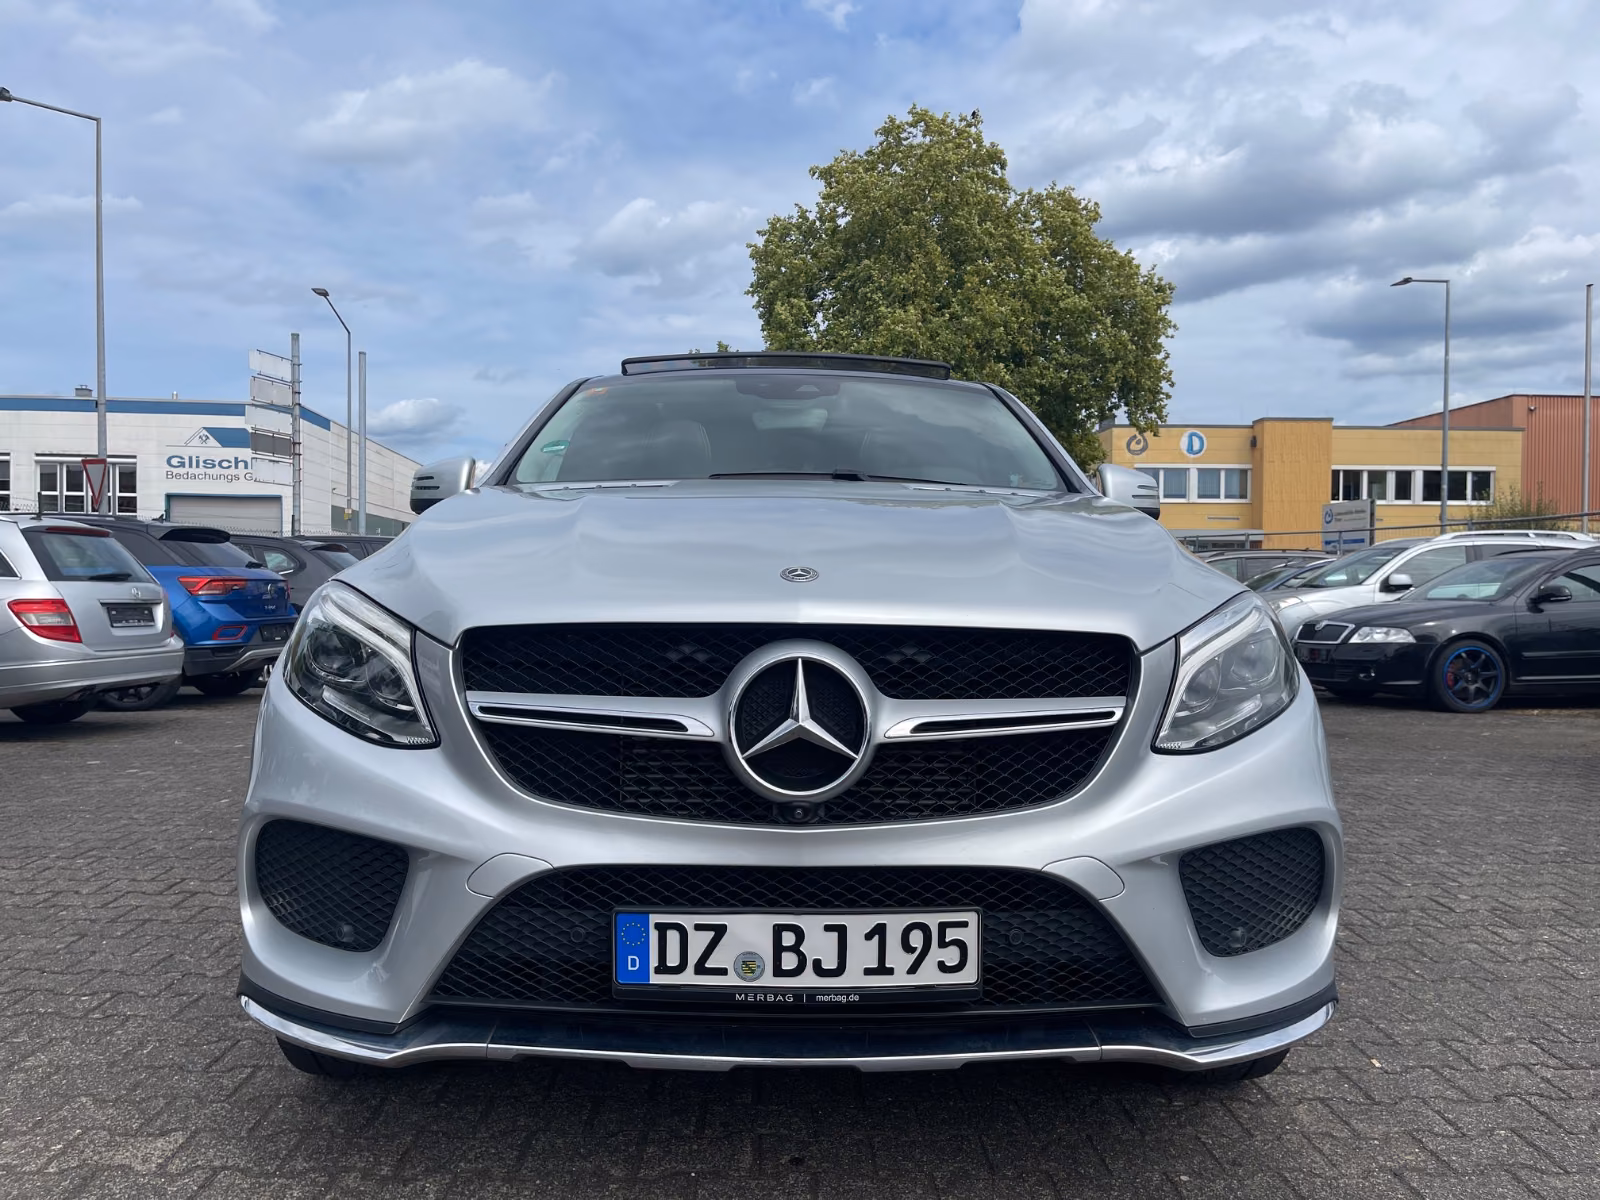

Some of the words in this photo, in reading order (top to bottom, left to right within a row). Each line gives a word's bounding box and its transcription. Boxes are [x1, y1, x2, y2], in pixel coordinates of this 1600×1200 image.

[166, 455, 253, 470] Glisch
[165, 470, 240, 483] Bedachungs
[653, 922, 729, 977] DZ
[772, 923, 848, 978] BJ
[863, 920, 970, 976] 195
[627, 955, 640, 971] D
[735, 993, 794, 1002] MERBAG
[815, 993, 860, 1003] merbag.de
